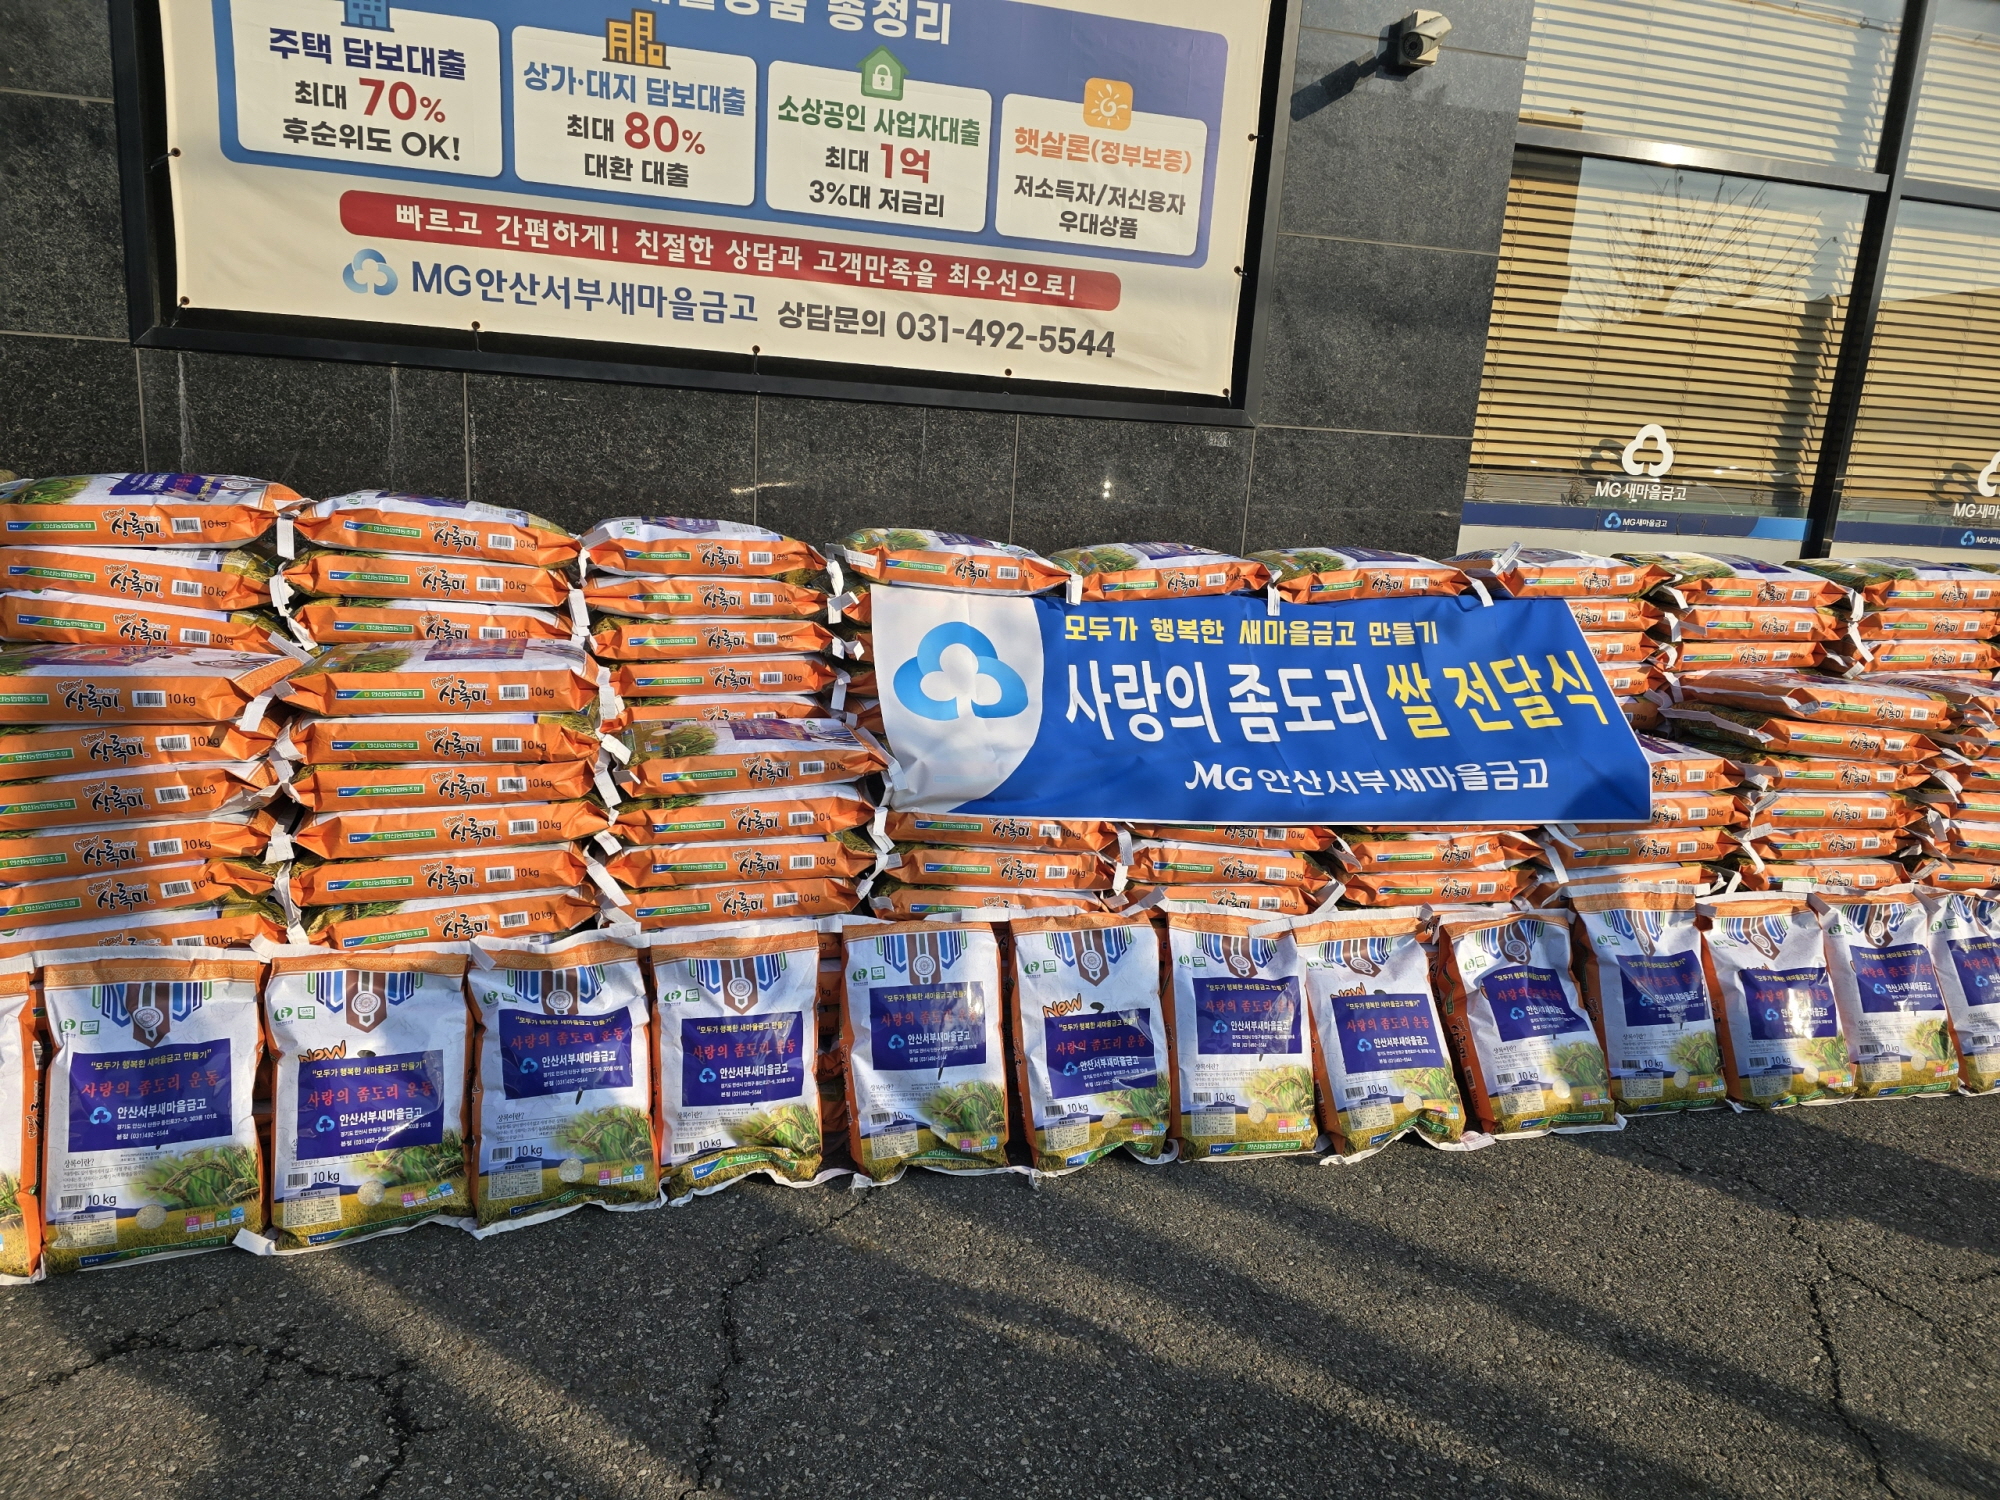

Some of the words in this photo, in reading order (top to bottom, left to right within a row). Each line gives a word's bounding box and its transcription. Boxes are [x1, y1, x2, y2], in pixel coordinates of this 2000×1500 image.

[828, 0, 950, 45] 총정리
[269, 27, 332, 64] 주택
[343, 35, 466, 81] 담보대출
[294, 80, 347, 110] 최대
[359, 77, 446, 123] 70%
[523, 61, 636, 103] 상가·대지
[646, 78, 746, 116] 담보대출
[566, 114, 614, 143] 최대
[624, 111, 706, 156] 80%
[777, 95, 867, 133] 소상공인
[873, 105, 981, 147] 사업자대출
[282, 117, 392, 153] 후순위도
[401, 132, 461, 161] OK!
[1013, 124, 1193, 175] 햇살론(정부보증)
[584, 153, 634, 181] 대환
[641, 160, 689, 188] 대출
[824, 145, 870, 173] 최대
[880, 142, 932, 184] 1억
[808, 179, 872, 210] 3%대
[878, 186, 945, 218] 저금리
[1013, 175, 1187, 216] 저소득자/저신용자
[1058, 210, 1139, 240] 우대상품
[395, 205, 483, 236] 빠르고
[495, 214, 620, 255] 간편하게!
[635, 228, 714, 267] 친절한
[724, 239, 802, 273] 상담과
[813, 246, 938, 290] 고객만족을
[947, 261, 1077, 301] 최우선으로!
[777, 300, 885, 338] 상담문의
[896, 311, 1117, 358] 031-492-5544
[111, 512, 160, 541] 상록미
[434, 525, 476, 552] 상록미
[702, 546, 740, 568] 상록미
[110, 569, 159, 598] 상록미
[422, 570, 465, 597] 상록미
[704, 589, 741, 611] 상록미
[1064, 615, 1138, 643] 모두가
[1151, 617, 1224, 647] 행복한
[1238, 618, 1357, 647] 새마을금고
[1369, 619, 1439, 647] 만들기
[530, 687, 543, 697] 10
[543, 687, 555, 698] kg
[714, 669, 752, 691] 상록미
[65, 684, 118, 716] 상록미
[168, 695, 181, 704] 10
[183, 694, 195, 706] kg
[439, 679, 486, 710] 상록미
[1065, 660, 1222, 744] 사랑의
[1228, 662, 1388, 743] 좀도리
[1386, 664, 1451, 740] 쌀
[1451, 649, 1610, 734] 전달식
[90, 735, 144, 764] 상록미
[434, 732, 480, 759] 상록미
[749, 759, 790, 785] 상록미
[439, 774, 485, 802] 상록미
[451, 818, 496, 845] 상록미
[538, 821, 549, 830] 10
[550, 821, 562, 831] kg
[83, 840, 136, 868] 상록미
[739, 852, 780, 878] 상록미
[815, 857, 825, 866] 10
[827, 856, 836, 867] kg
[427, 866, 473, 893] 상록미
[98, 883, 148, 911] 상록미
[723, 892, 764, 917] 상록미
[1042, 993, 1082, 1018] New
[1206, 999, 1236, 1013] 사랑의
[1242, 1000, 1272, 1013] 좀도리
[1347, 1018, 1377, 1032] 사랑의
[1381, 1016, 1410, 1030] 좀도리
[1413, 1016, 1430, 1029] 운동
[298, 1040, 346, 1062] New
[511, 1032, 550, 1050] 사랑의
[557, 1032, 594, 1046] 좀도리
[602, 1028, 624, 1041] 운동
[907, 1031, 970, 1046] 안산서부새마을금고
[1056, 1040, 1086, 1055] 사랑의
[1091, 1037, 1121, 1052] 좀도리
[1127, 1034, 1146, 1047] 운동
[542, 1050, 616, 1068] 안산서부새마을금고
[693, 1044, 728, 1060] 사랑의
[1080, 1056, 1139, 1072] 안산서부새마을금고
[1644, 1059, 1653, 1068] 10
[1655, 1059, 1664, 1069] kg
[1771, 1056, 1780, 1065] 10
[1782, 1056, 1791, 1066] kg
[81, 1081, 130, 1099] 사랑의
[137, 1073, 180, 1097] 좀도리
[188, 1069, 220, 1089] 운동
[720, 1063, 788, 1080] 안산서부새마을금고
[1518, 1072, 1527, 1081] 10
[1528, 1071, 1538, 1081] kg
[308, 1088, 349, 1107] 사랑의
[357, 1084, 398, 1103] 좀도리
[406, 1081, 433, 1098] 운동
[1215, 1093, 1224, 1101] 10
[1226, 1093, 1236, 1102] kg
[1367, 1085, 1377, 1094] 10
[1379, 1085, 1388, 1094] kg
[117, 1098, 207, 1120] 안산서부새마을금고
[340, 1107, 422, 1127] 안산서부새마을금고
[1067, 1104, 1077, 1113] 10
[1078, 1103, 1088, 1113] kg
[517, 1145, 529, 1156] 10
[531, 1145, 543, 1156] kg
[698, 1139, 709, 1149] 10
[711, 1138, 722, 1149] kg
[313, 1171, 326, 1182] 10
[328, 1171, 340, 1183] kg
[88, 1194, 100, 1206] 10
[103, 1194, 117, 1207] kg
